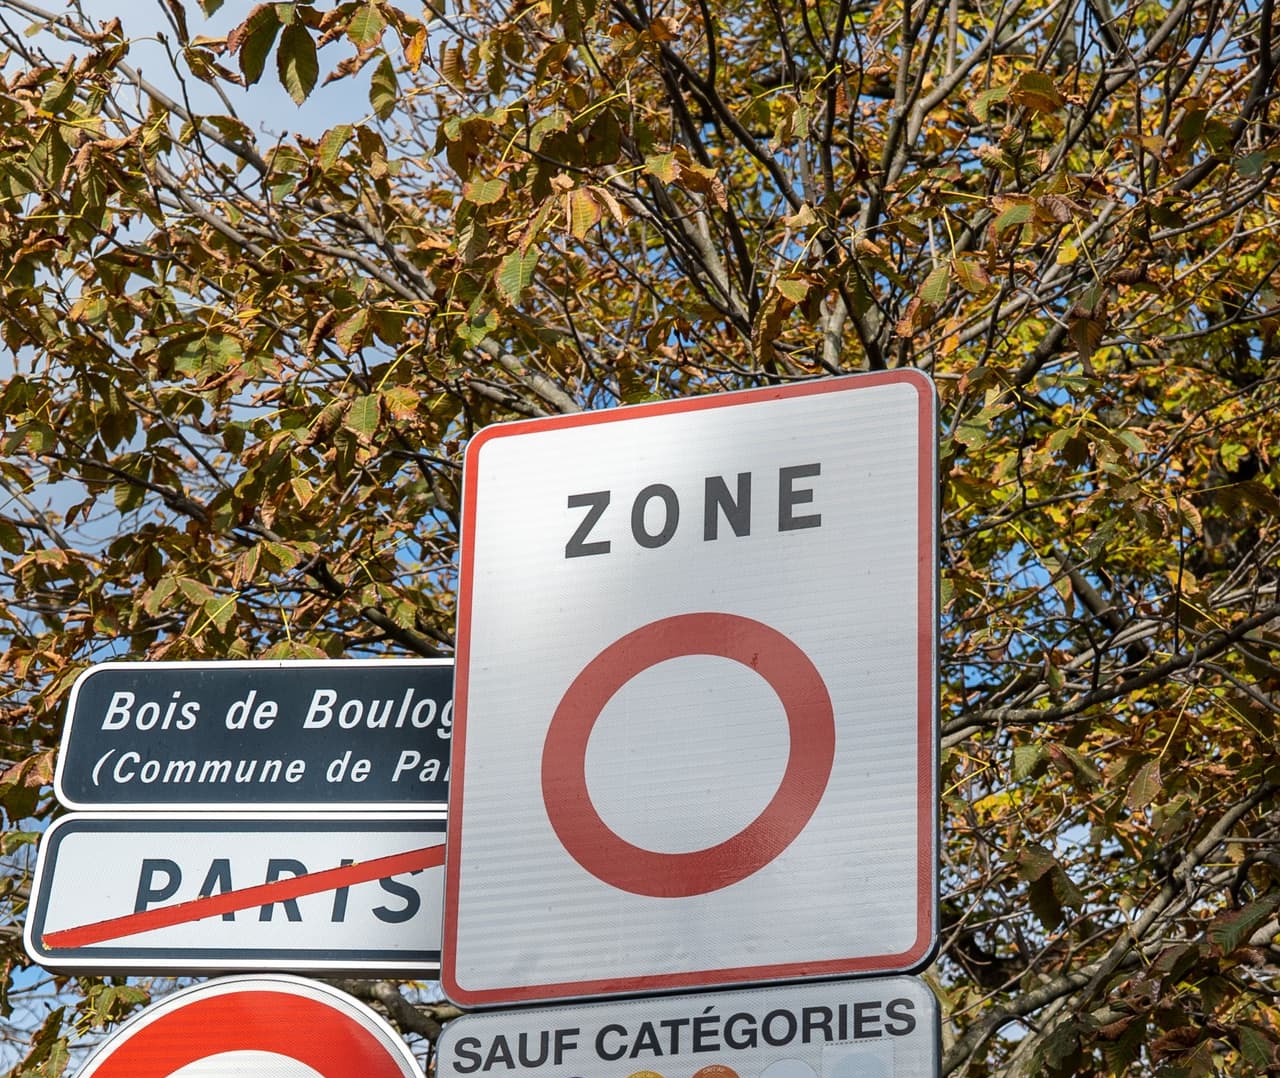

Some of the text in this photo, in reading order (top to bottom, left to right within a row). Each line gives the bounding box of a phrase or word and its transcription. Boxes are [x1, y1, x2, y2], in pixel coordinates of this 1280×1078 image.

[565, 462, 821, 558] ZONE
[101, 690, 200, 730] Bois
[225, 690, 278, 729] de
[92, 749, 305, 786] (Commune
[326, 751, 369, 782] de
[133, 858, 425, 924] PARIS
[452, 998, 916, 1074] SAUF CATÉGORIES
